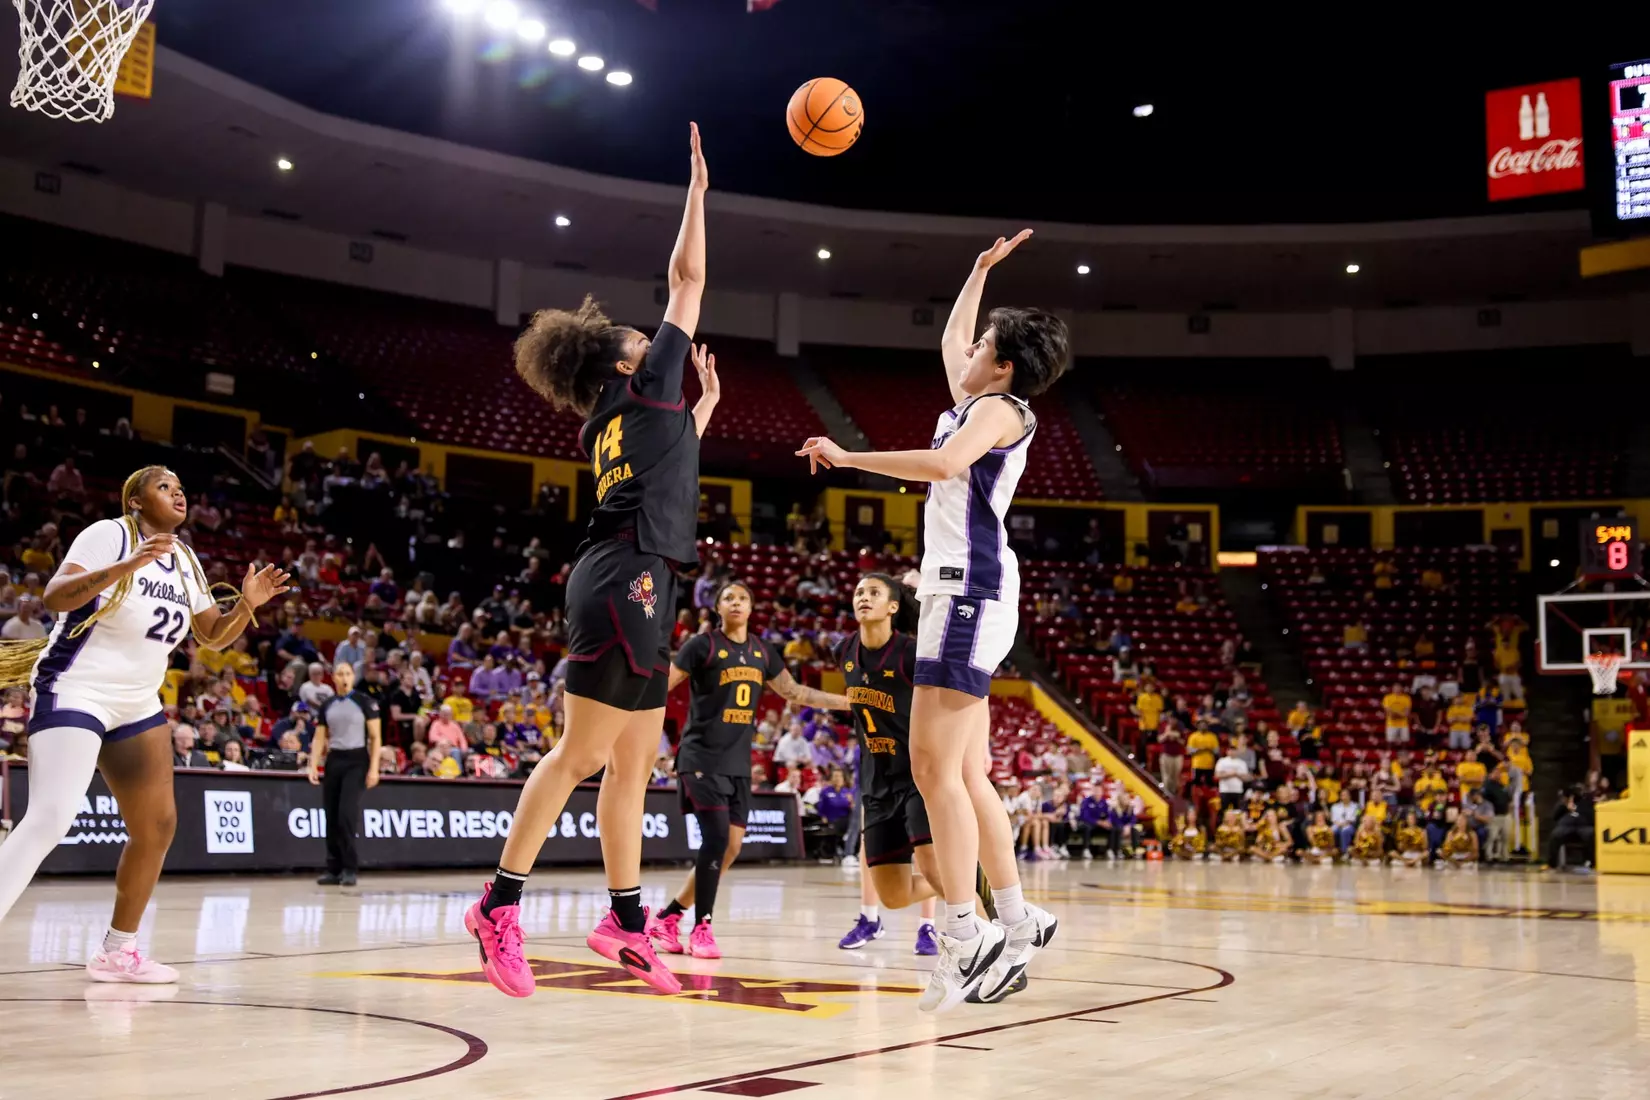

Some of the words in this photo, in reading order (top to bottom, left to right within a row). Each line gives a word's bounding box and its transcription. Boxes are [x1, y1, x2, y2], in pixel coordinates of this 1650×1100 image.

[594, 414, 623, 478] 14
[1596, 525, 1631, 544] 5:44
[1608, 541, 1628, 570] 8
[138, 576, 191, 609] Wildcats
[144, 606, 185, 645] 22
[736, 683, 751, 707] 0
[862, 708, 877, 733] 1
[214, 800, 244, 813] YOU
[219, 816, 240, 828] DO
[363, 809, 446, 839] RIVER
[560, 811, 577, 838] &
[215, 831, 246, 844] YOU
[1602, 827, 1650, 846] KI
